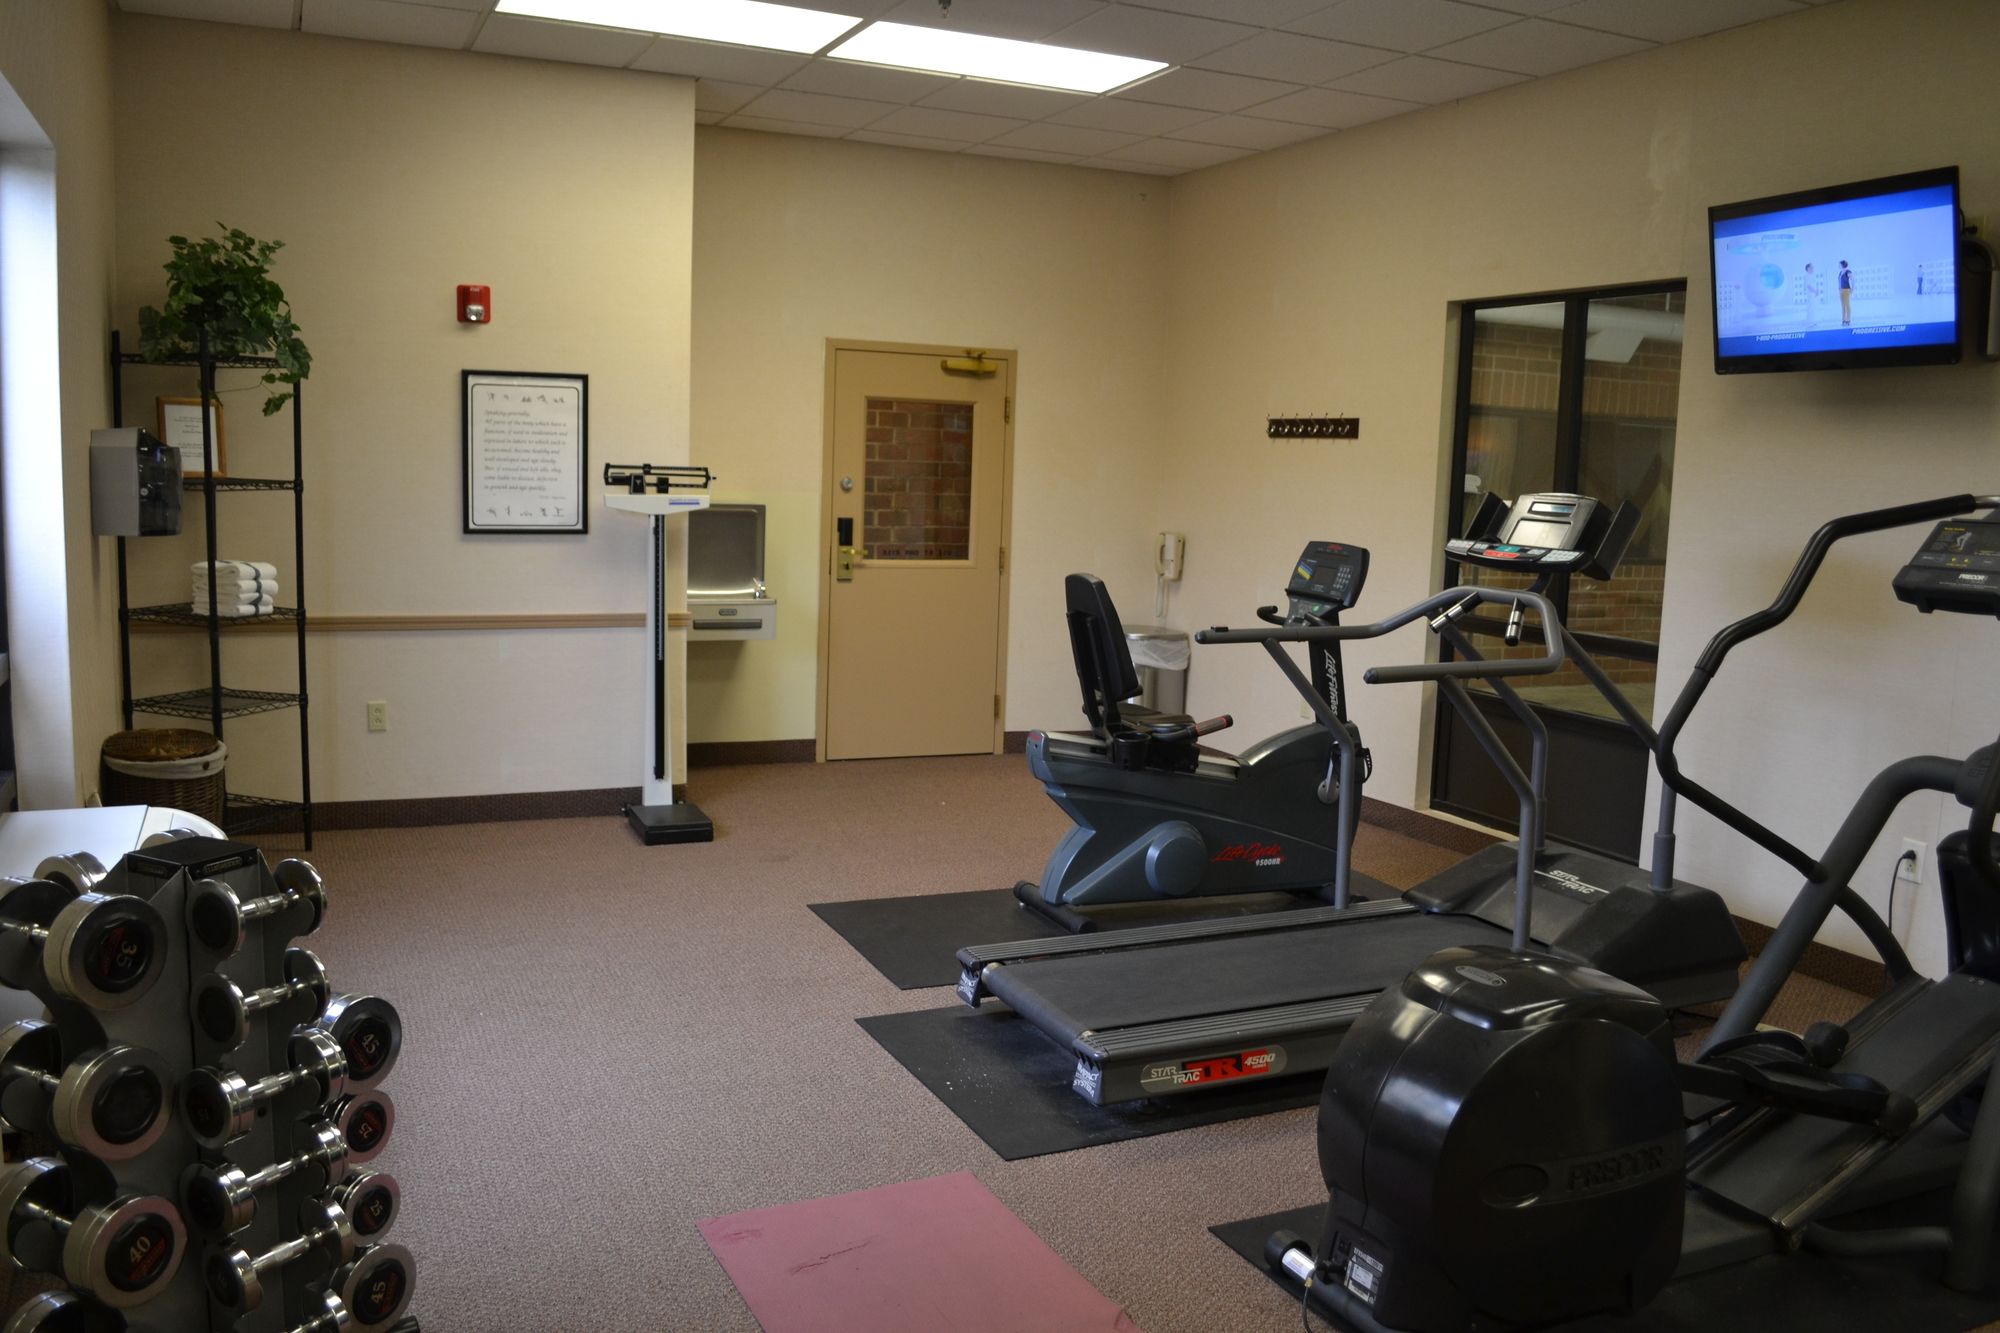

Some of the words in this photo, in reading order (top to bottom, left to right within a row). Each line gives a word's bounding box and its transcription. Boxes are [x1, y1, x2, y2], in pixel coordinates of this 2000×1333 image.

[1549, 869, 1580, 882] STAR
[1561, 880, 1595, 894] TRAC
[116, 940, 138, 967] 35
[362, 1033, 380, 1054] 45
[1244, 1053, 1275, 1066] 4500
[1151, 1066, 1177, 1078] STAR
[1172, 1071, 1200, 1084] TRAC
[359, 1122, 373, 1139] 25
[1567, 1145, 1664, 1192] PRECOR
[369, 1199, 383, 1217] 25
[130, 1236, 151, 1264] 40
[371, 1280, 387, 1304] 45
